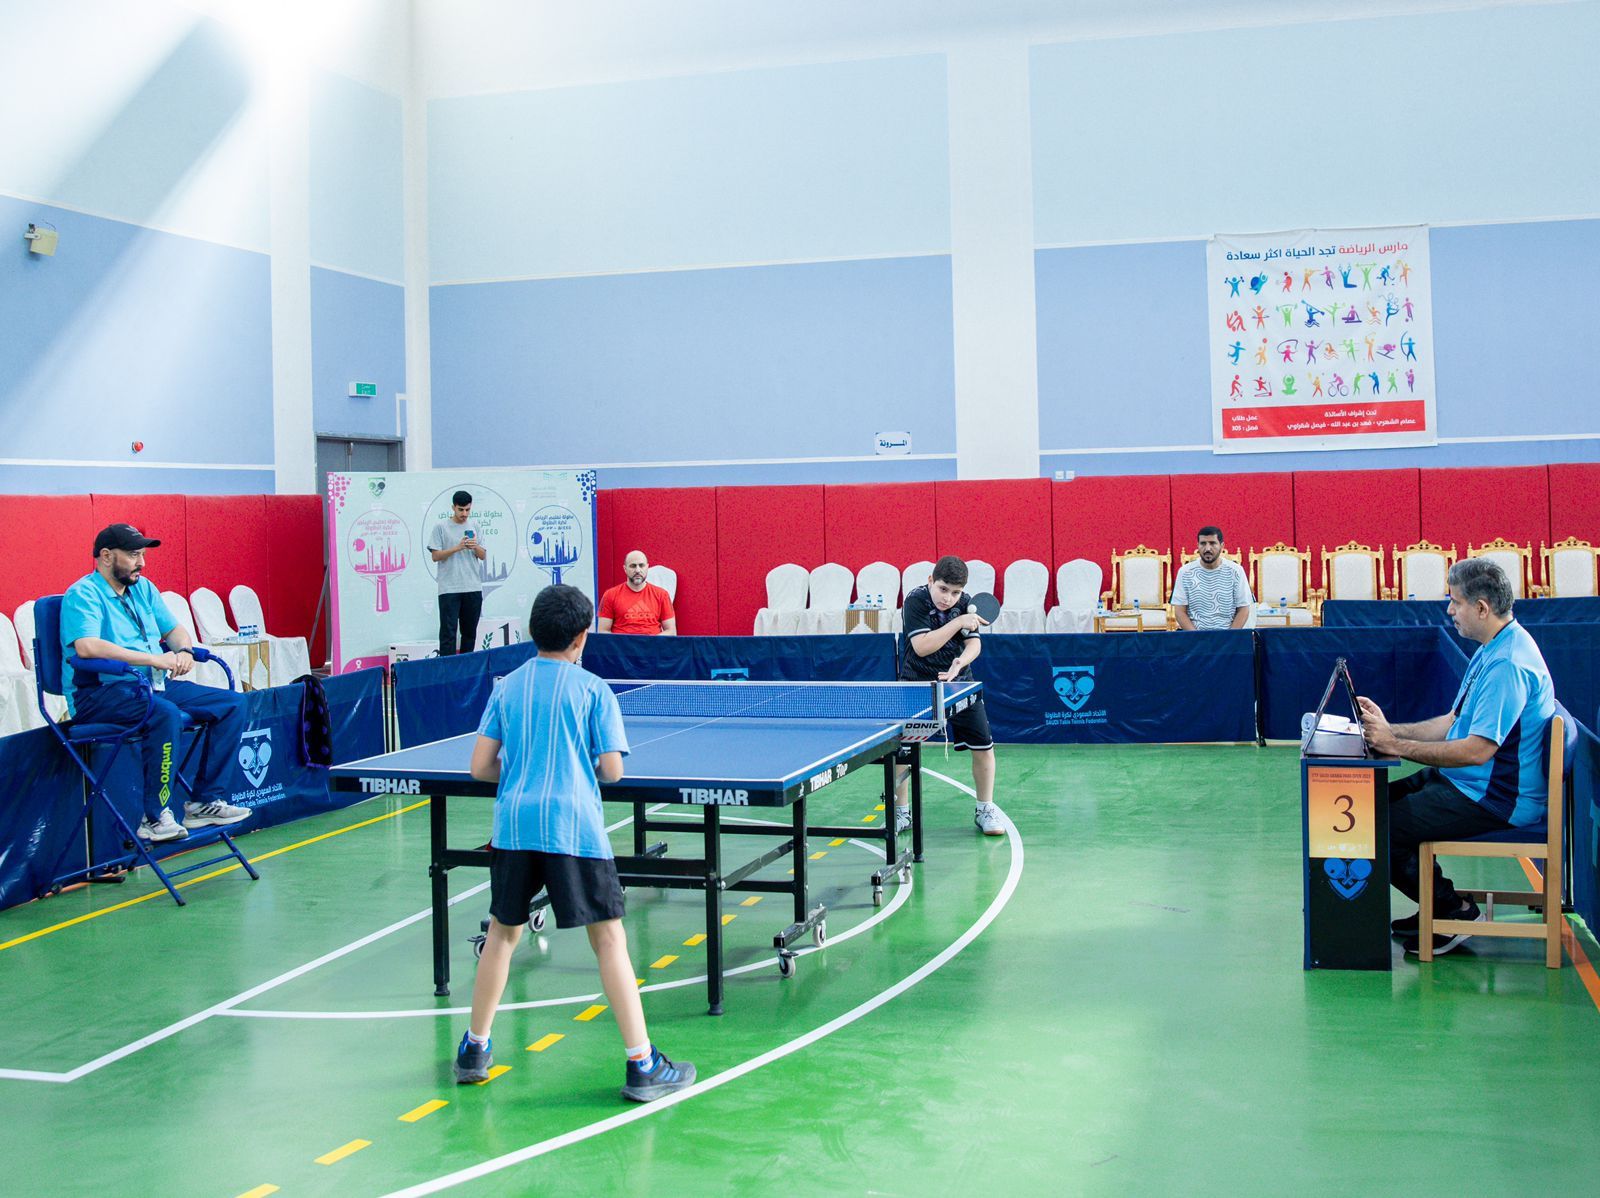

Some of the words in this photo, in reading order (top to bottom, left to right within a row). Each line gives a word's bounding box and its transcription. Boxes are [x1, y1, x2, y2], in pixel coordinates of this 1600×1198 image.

[1226, 250, 1260, 261] سعادة
[1285, 246, 1315, 259] الحياة
[1318, 245, 1336, 258] تجد
[1378, 242, 1408, 254] مارس
[498, 622, 509, 646] 1
[160, 742, 172, 784] umbro
[359, 778, 420, 794] TIBHAR
[679, 788, 749, 805] TIBHAR
[1332, 794, 1356, 833] 3
